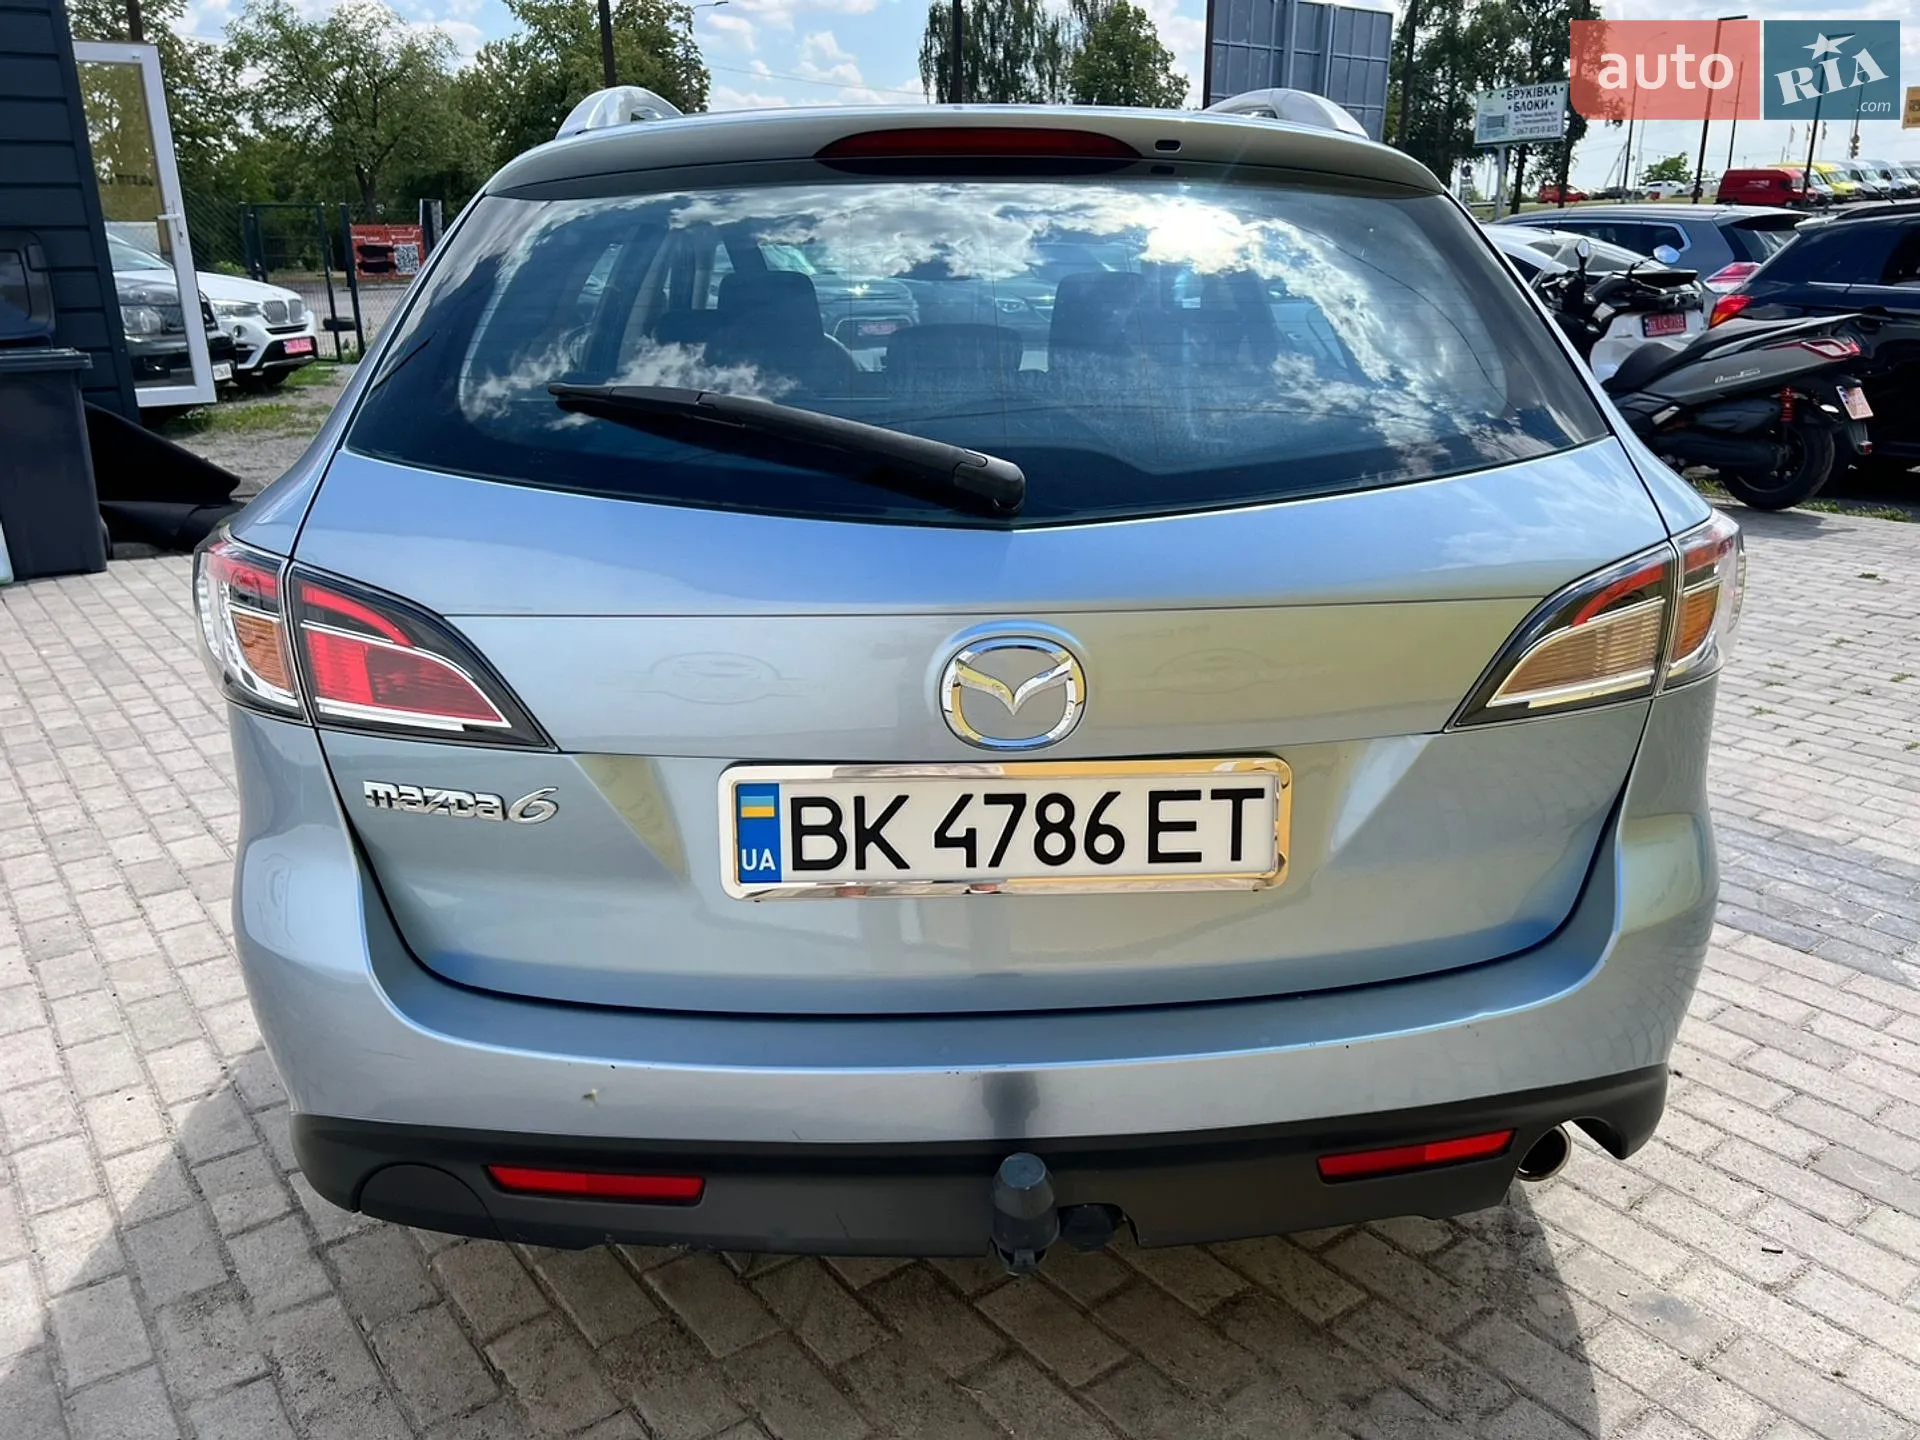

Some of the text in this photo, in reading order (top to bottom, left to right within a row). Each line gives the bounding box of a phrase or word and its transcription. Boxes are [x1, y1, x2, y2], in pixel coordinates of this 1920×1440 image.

[1507, 85, 1557, 100] БРУКІВКА
[1513, 99, 1548, 112] БЛОКИ
[790, 788, 1266, 871] BK 4786 ET
[741, 848, 776, 871] UA
